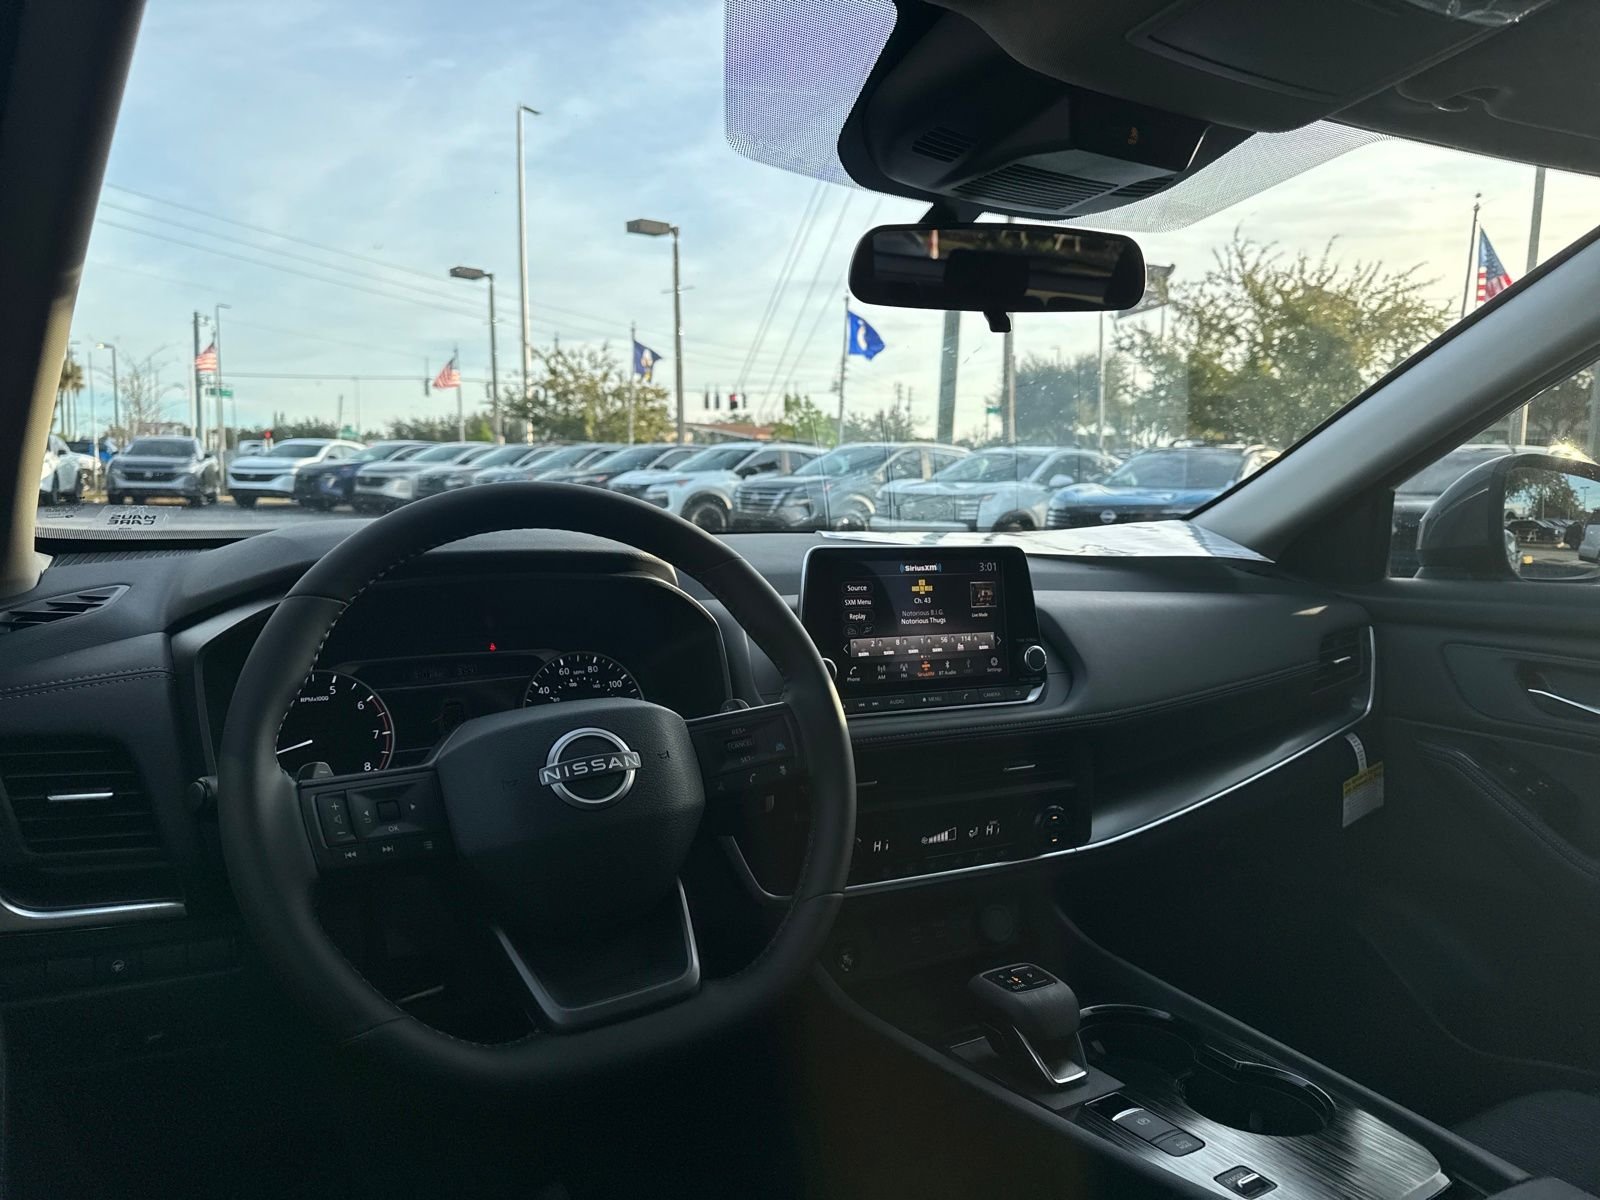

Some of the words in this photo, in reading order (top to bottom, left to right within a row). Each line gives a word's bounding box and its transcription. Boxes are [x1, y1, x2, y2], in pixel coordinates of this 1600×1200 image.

[979, 562, 997, 572] 3:01
[847, 584, 867, 592] Source
[858, 598, 872, 606] Menu
[849, 613, 867, 621] Replay
[930, 617, 946, 625] Thugs
[941, 636, 948, 644] 56
[961, 635, 971, 643] 114
[558, 666, 570, 676] 60
[587, 665, 599, 674] 80
[608, 679, 623, 689] 100
[329, 685, 337, 695] 5
[538, 685, 550, 695] 40
[357, 700, 365, 710] 6
[372, 729, 380, 740] 7
[363, 761, 372, 772] 8
[543, 754, 640, 783] NISSAN
[388, 825, 400, 833] OK
